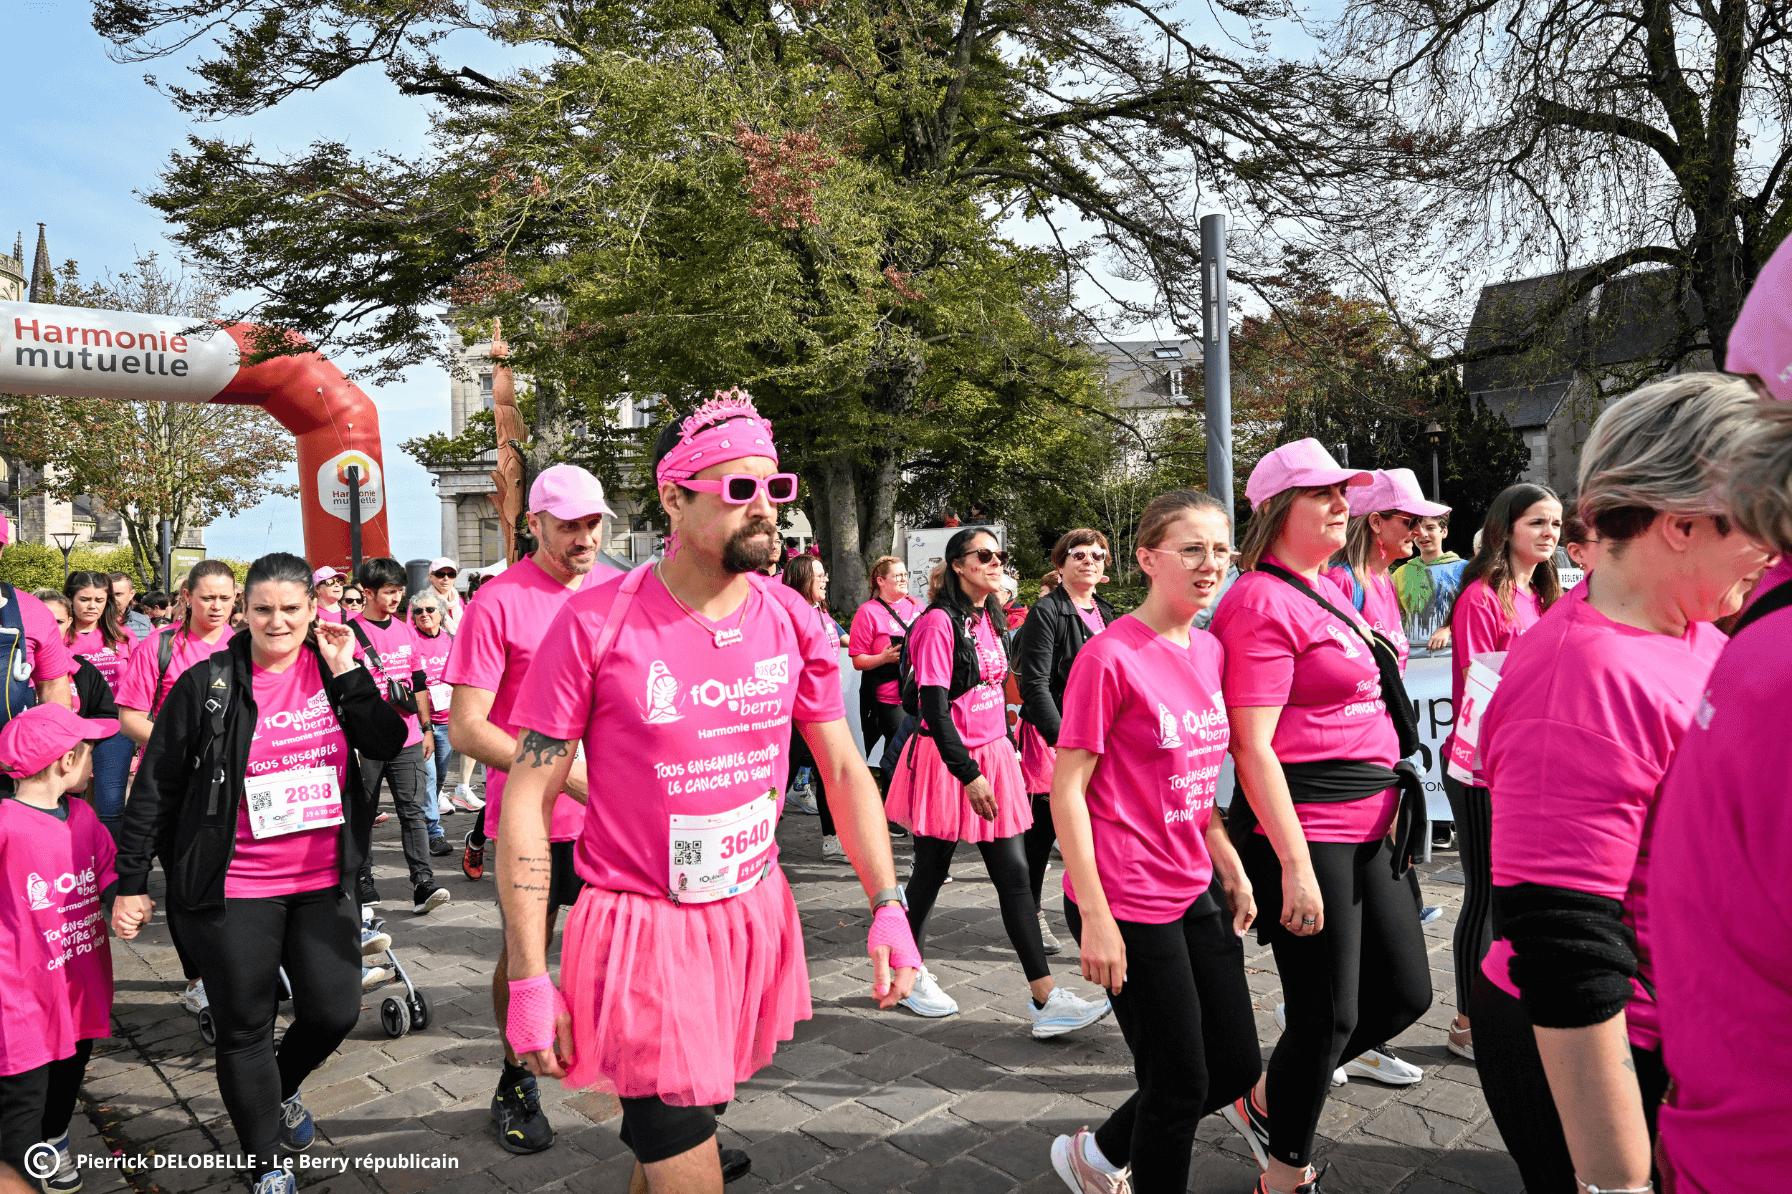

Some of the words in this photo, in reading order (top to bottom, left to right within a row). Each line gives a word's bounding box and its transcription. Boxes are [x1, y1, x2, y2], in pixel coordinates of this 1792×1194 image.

[14, 317, 188, 354] Harmonie
[15, 345, 189, 378] mutuelle
[332, 490, 376, 498] Haronie
[333, 497, 377, 505] muelle
[740, 698, 782, 717] berry
[302, 715, 334, 732] berry
[698, 723, 750, 739] Harmonie
[272, 732, 313, 747] Harmonie
[314, 724, 343, 737] mutuell
[248, 759, 279, 774] TOUS
[282, 743, 338, 766] ENSEMBLE
[654, 762, 685, 779] TOUS
[687, 752, 746, 775] ENSEMBLE
[667, 781, 683, 796] LE
[685, 772, 732, 794] CANCER
[733, 769, 749, 785] DU
[751, 764, 772, 781] SEIN
[1168, 774, 1189, 791] TOU
[1187, 763, 1221, 783] ENSEMB
[285, 783, 332, 804] 2838
[1165, 806, 1194, 824] CANC
[720, 818, 769, 859] 3640
